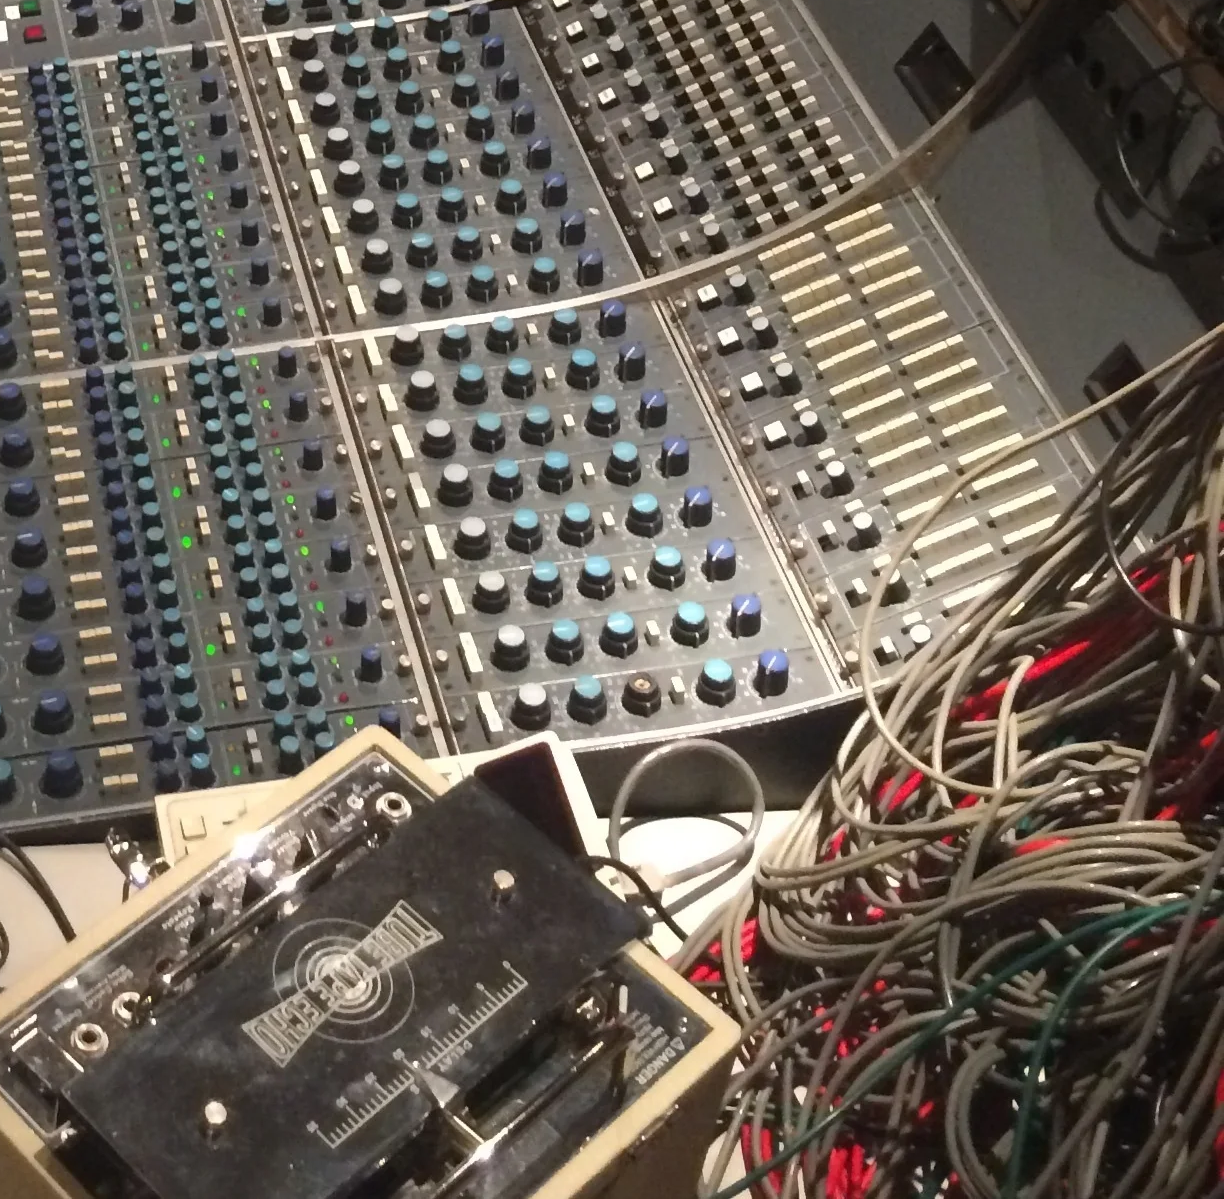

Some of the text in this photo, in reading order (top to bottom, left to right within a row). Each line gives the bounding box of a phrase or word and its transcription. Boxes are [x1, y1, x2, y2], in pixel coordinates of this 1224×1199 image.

[251, 907, 440, 1059] TUBE TAPE ECHO
[437, 1039, 474, 1074] DELAY
[635, 1046, 676, 1085] DANGER
